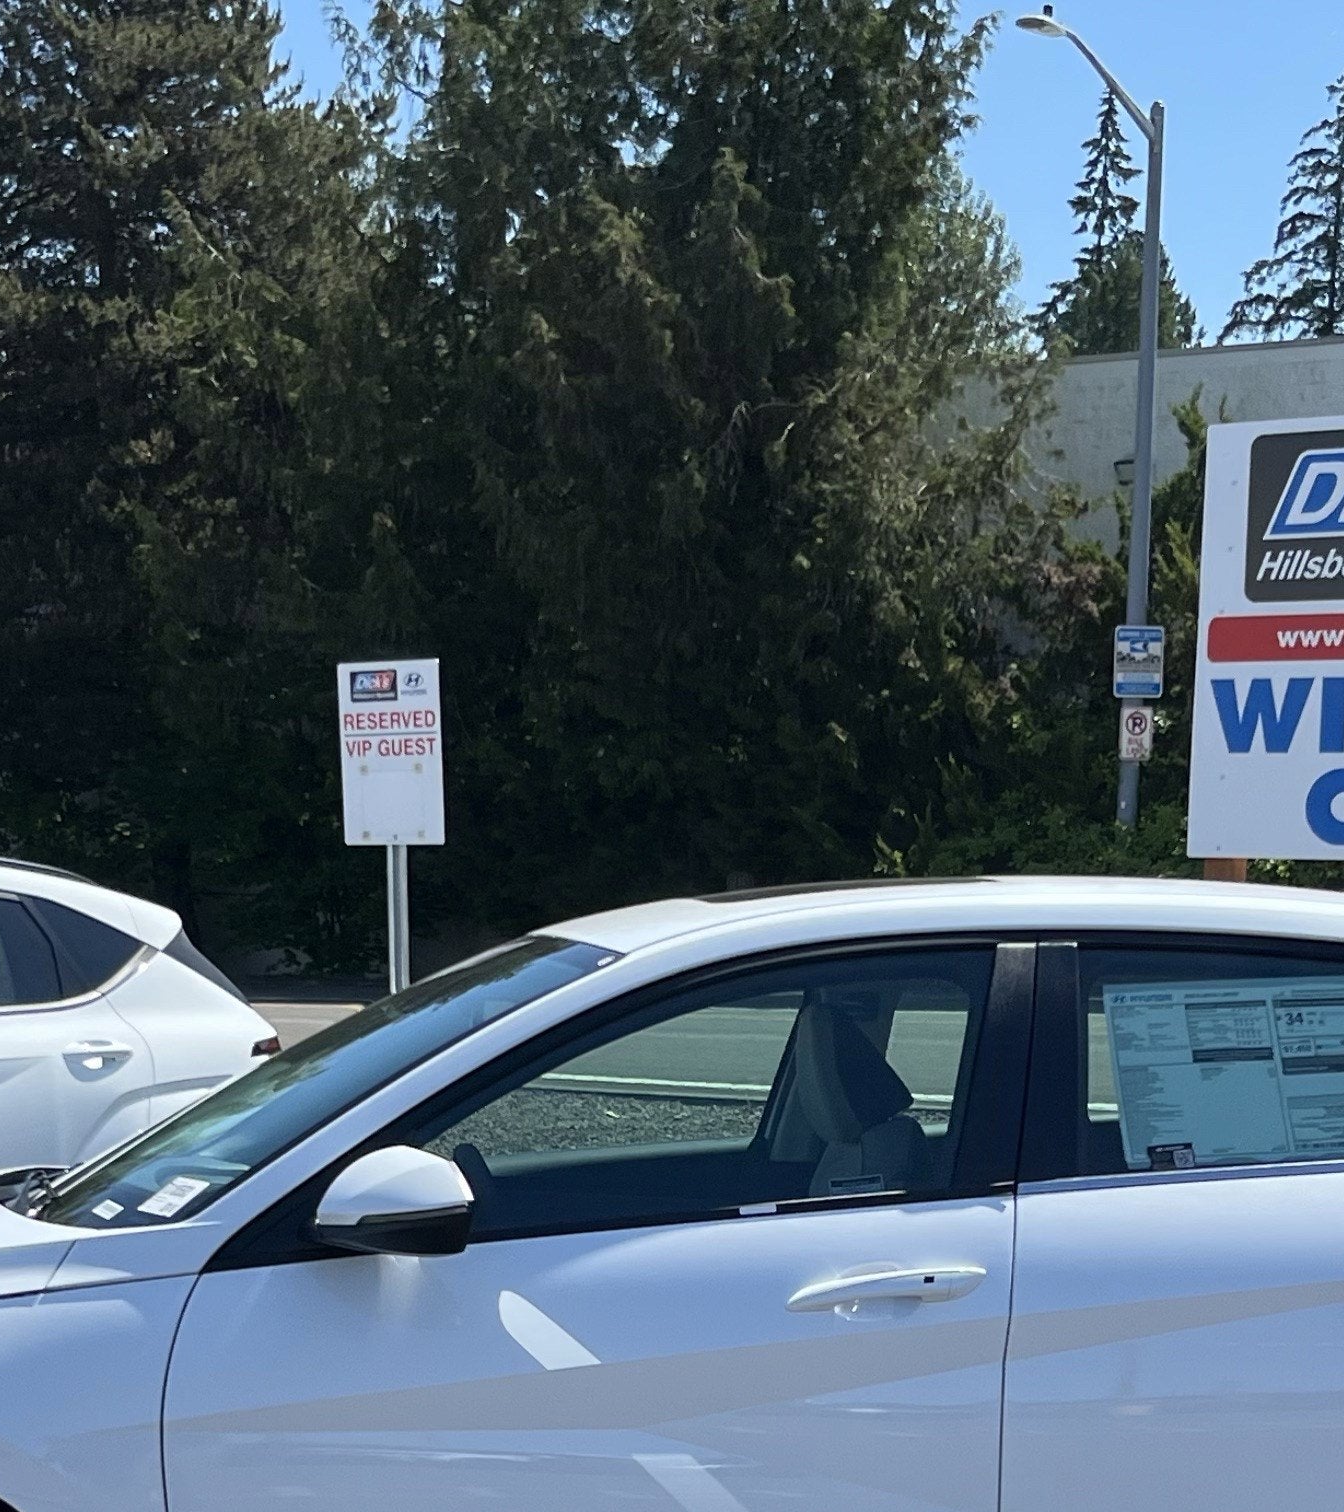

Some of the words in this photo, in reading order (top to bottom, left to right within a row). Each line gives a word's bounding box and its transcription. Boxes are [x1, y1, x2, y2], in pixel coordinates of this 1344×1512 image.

[344, 710, 436, 730] RESERVED
[346, 740, 372, 757] VIP
[378, 738, 436, 757] GUEST
[1284, 1012, 1303, 1026] 34
